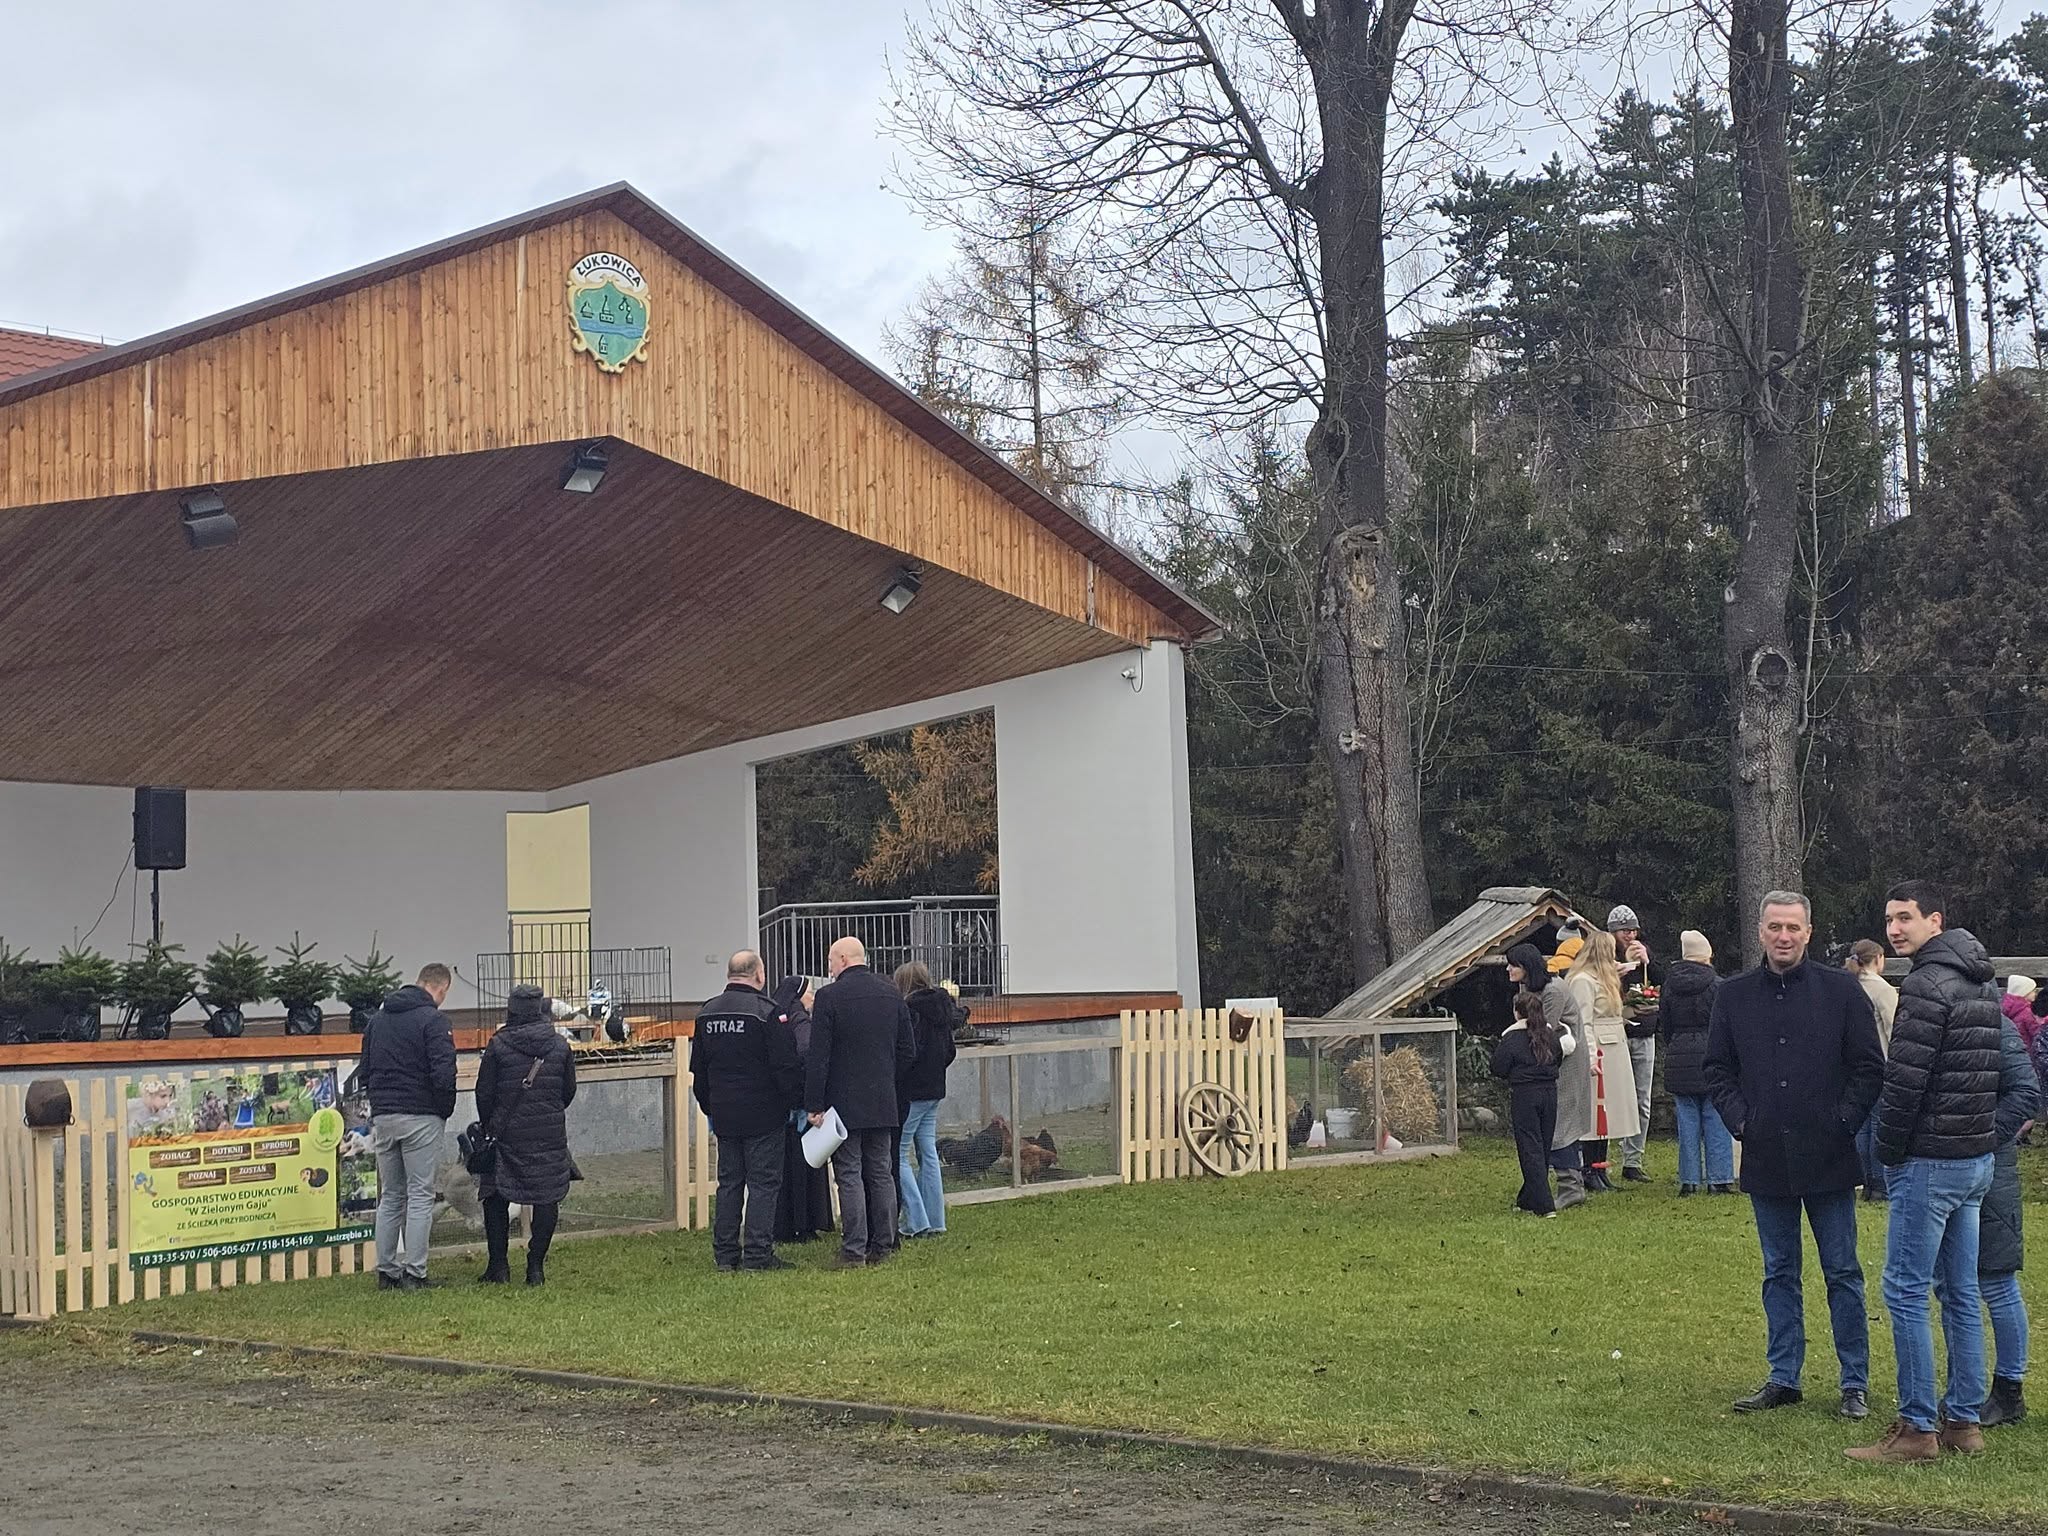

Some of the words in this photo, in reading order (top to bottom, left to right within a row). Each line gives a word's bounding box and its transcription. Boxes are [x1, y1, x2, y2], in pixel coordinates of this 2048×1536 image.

[577, 255, 641, 287] ŁUKOWICA
[212, 1145, 243, 1156] DOTKNIJ
[262, 1140, 293, 1151] SPRÓBUJ
[160, 1151, 191, 1161] ZOBACZ
[239, 1163, 267, 1175] ZOSTAŃ
[188, 1170, 217, 1181] POZNAJ
[152, 1192, 237, 1208] GOSPODARSTWO
[238, 1185, 299, 1200] EDUKACYJNE
[201, 1204, 244, 1215] Zielonym
[177, 1222, 187, 1230] ZE
[187, 1219, 219, 1229] ŚCIEŻKĄ
[220, 1211, 276, 1225] PRZYRODNICZĄ
[363, 1229, 373, 1238] 31
[139, 1256, 150, 1266] 18
[152, 1250, 196, 1265] 33-35-570
[202, 1242, 255, 1258] 506-505-677
[262, 1235, 314, 1251] 518-154-169
